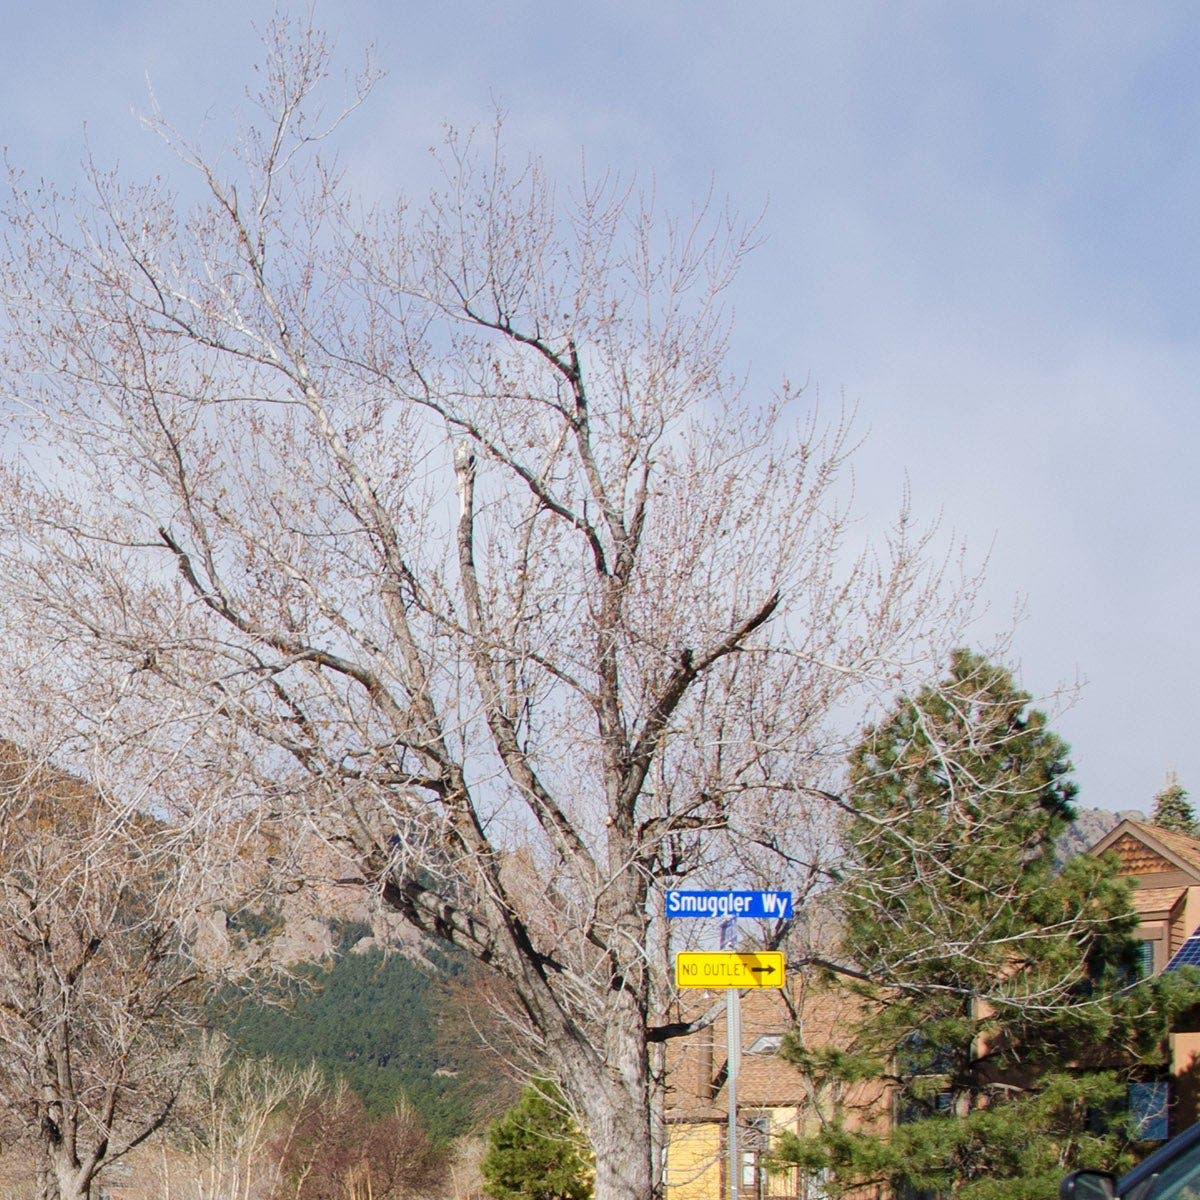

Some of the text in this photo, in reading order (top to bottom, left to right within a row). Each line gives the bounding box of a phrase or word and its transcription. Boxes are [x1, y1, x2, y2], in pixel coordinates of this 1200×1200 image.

[668, 892, 788, 917] Smuggler Wy
[682, 963, 749, 976] NO OUTLET
